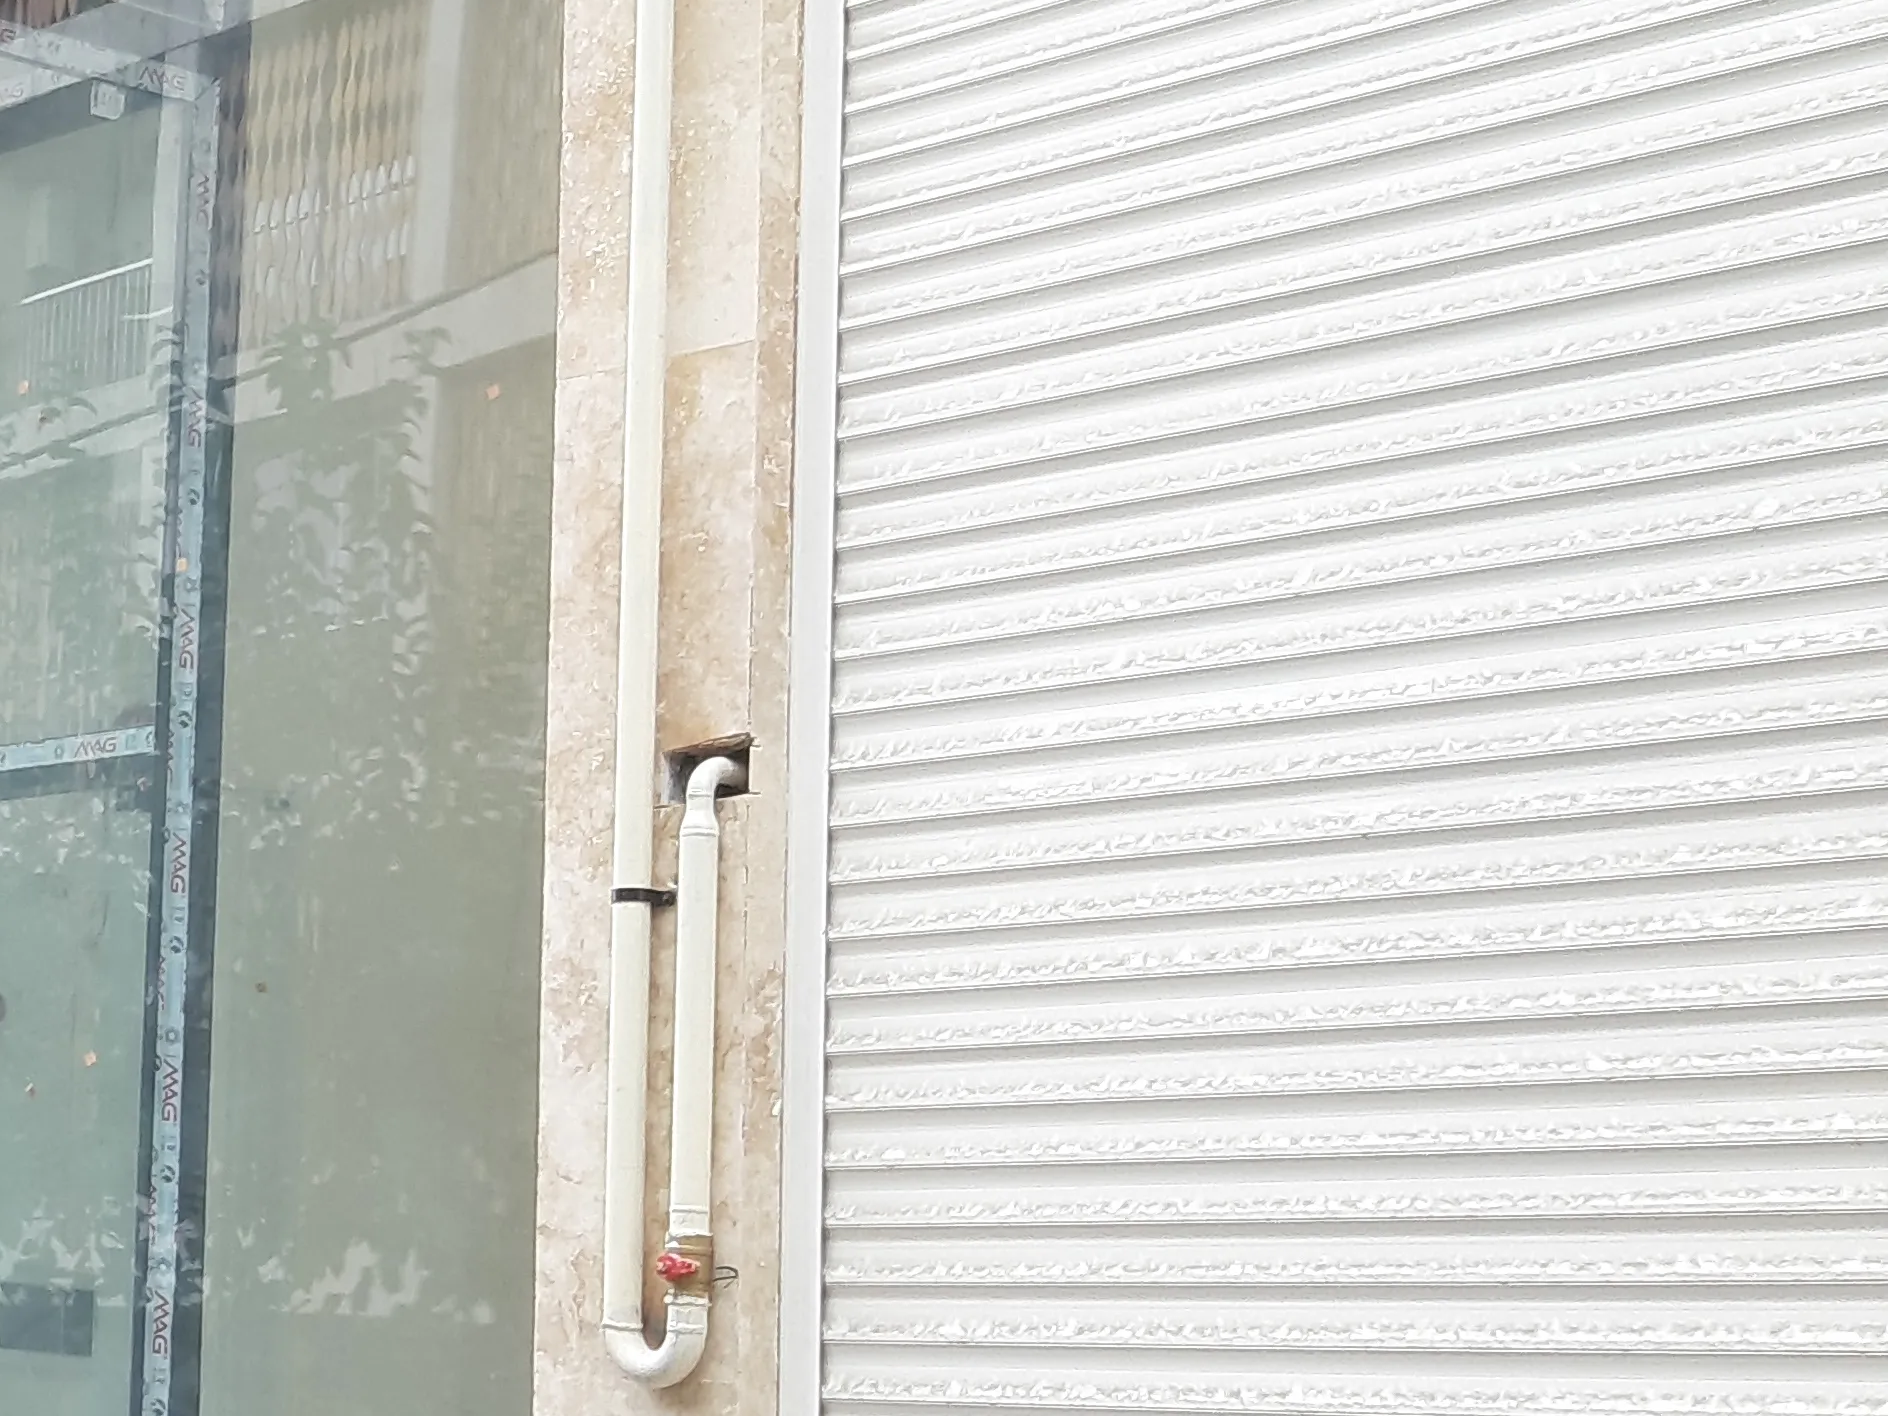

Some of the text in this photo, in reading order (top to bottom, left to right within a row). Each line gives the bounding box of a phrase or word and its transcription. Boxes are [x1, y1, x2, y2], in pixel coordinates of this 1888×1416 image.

[179, 613, 195, 670] MAG
[74, 737, 117, 758] MAG
[171, 832, 187, 894] MAG
[162, 1058, 178, 1122] MAG
[152, 1291, 169, 1358] MAG
